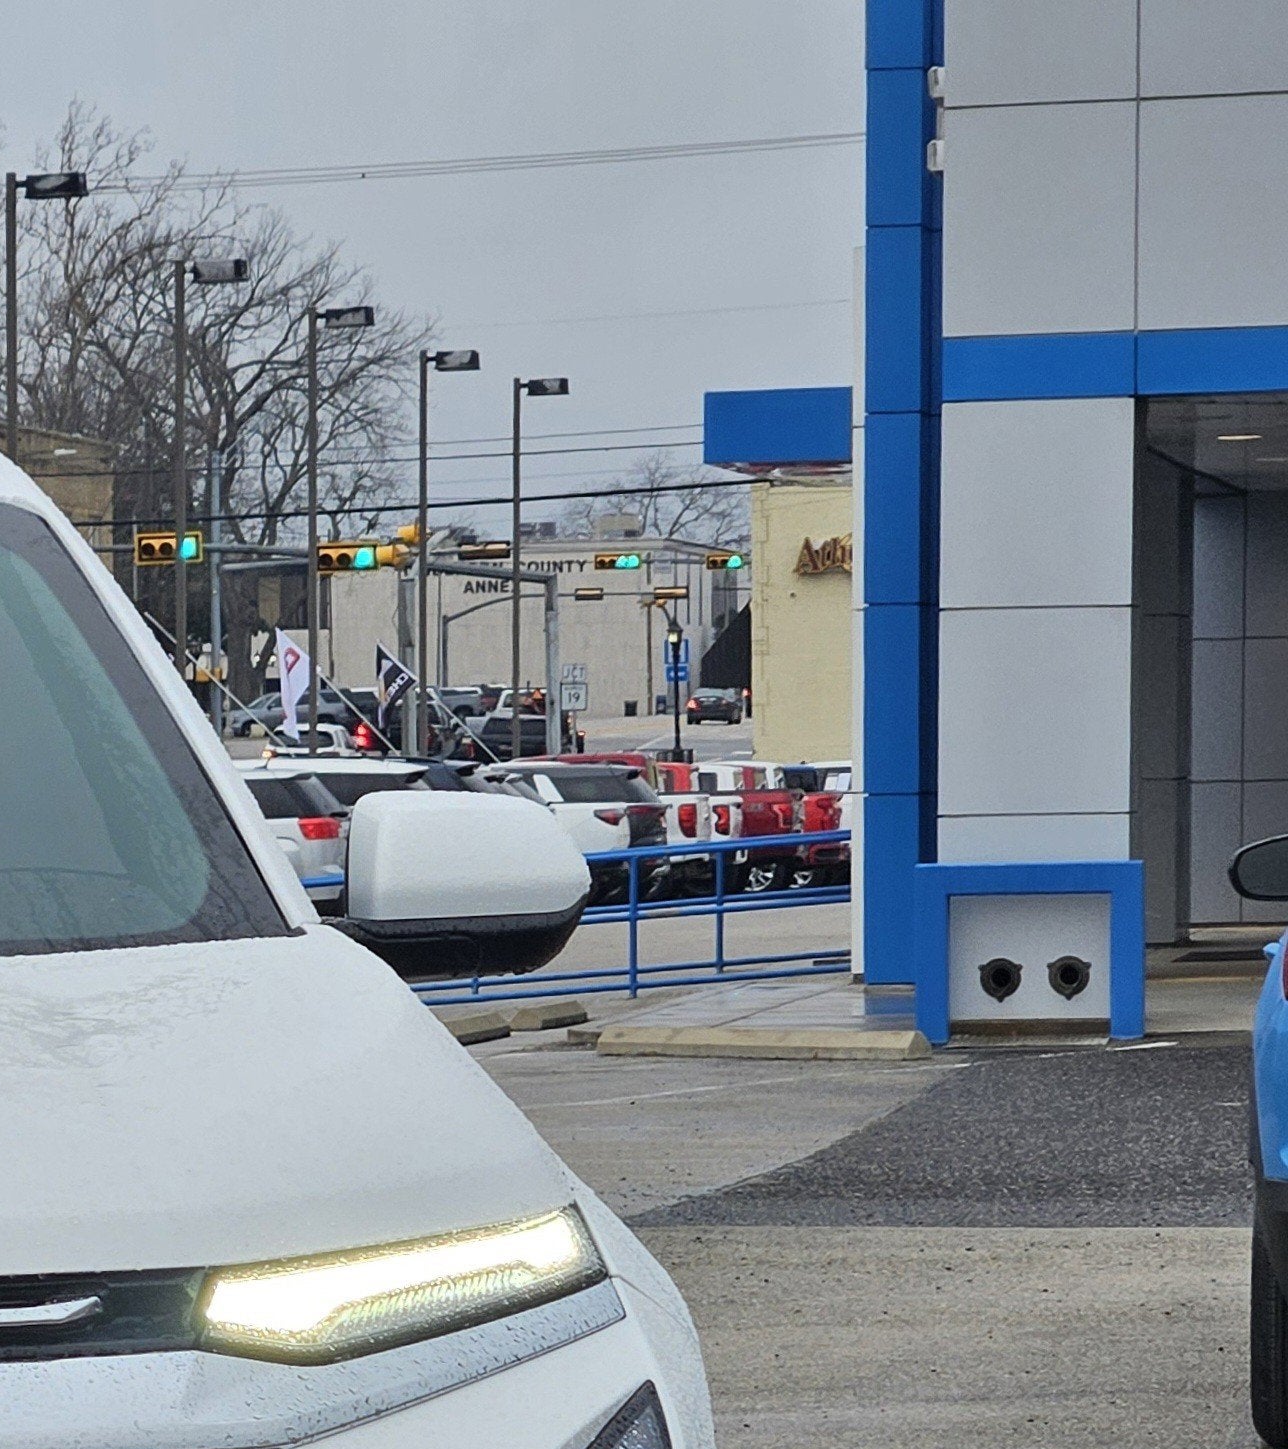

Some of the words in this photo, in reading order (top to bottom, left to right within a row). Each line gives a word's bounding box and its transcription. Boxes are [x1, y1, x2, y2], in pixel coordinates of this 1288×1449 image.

[516, 560, 588, 573] OUNTY
[463, 580, 520, 594] ANNE
[564, 666, 584, 679] JCT
[568, 691, 581, 703] 19
